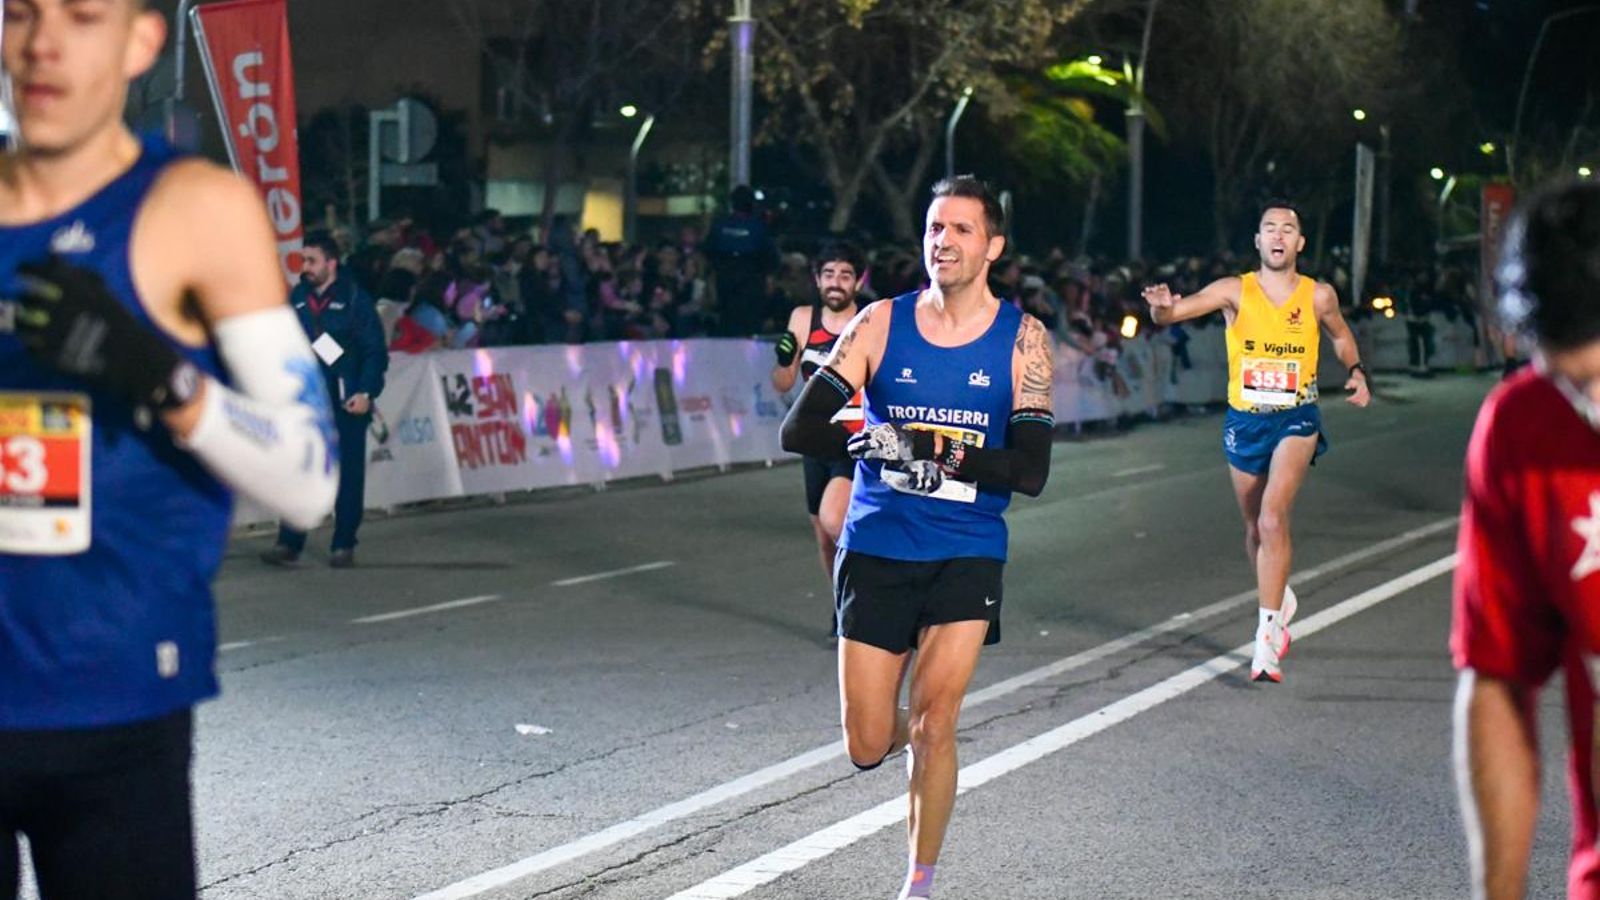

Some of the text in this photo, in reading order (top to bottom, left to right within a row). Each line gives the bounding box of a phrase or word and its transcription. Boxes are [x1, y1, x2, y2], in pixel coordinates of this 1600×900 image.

[441, 373, 517, 417] 42 SAN
[1251, 370, 1288, 388] 353
[0, 435, 48, 493] 3
